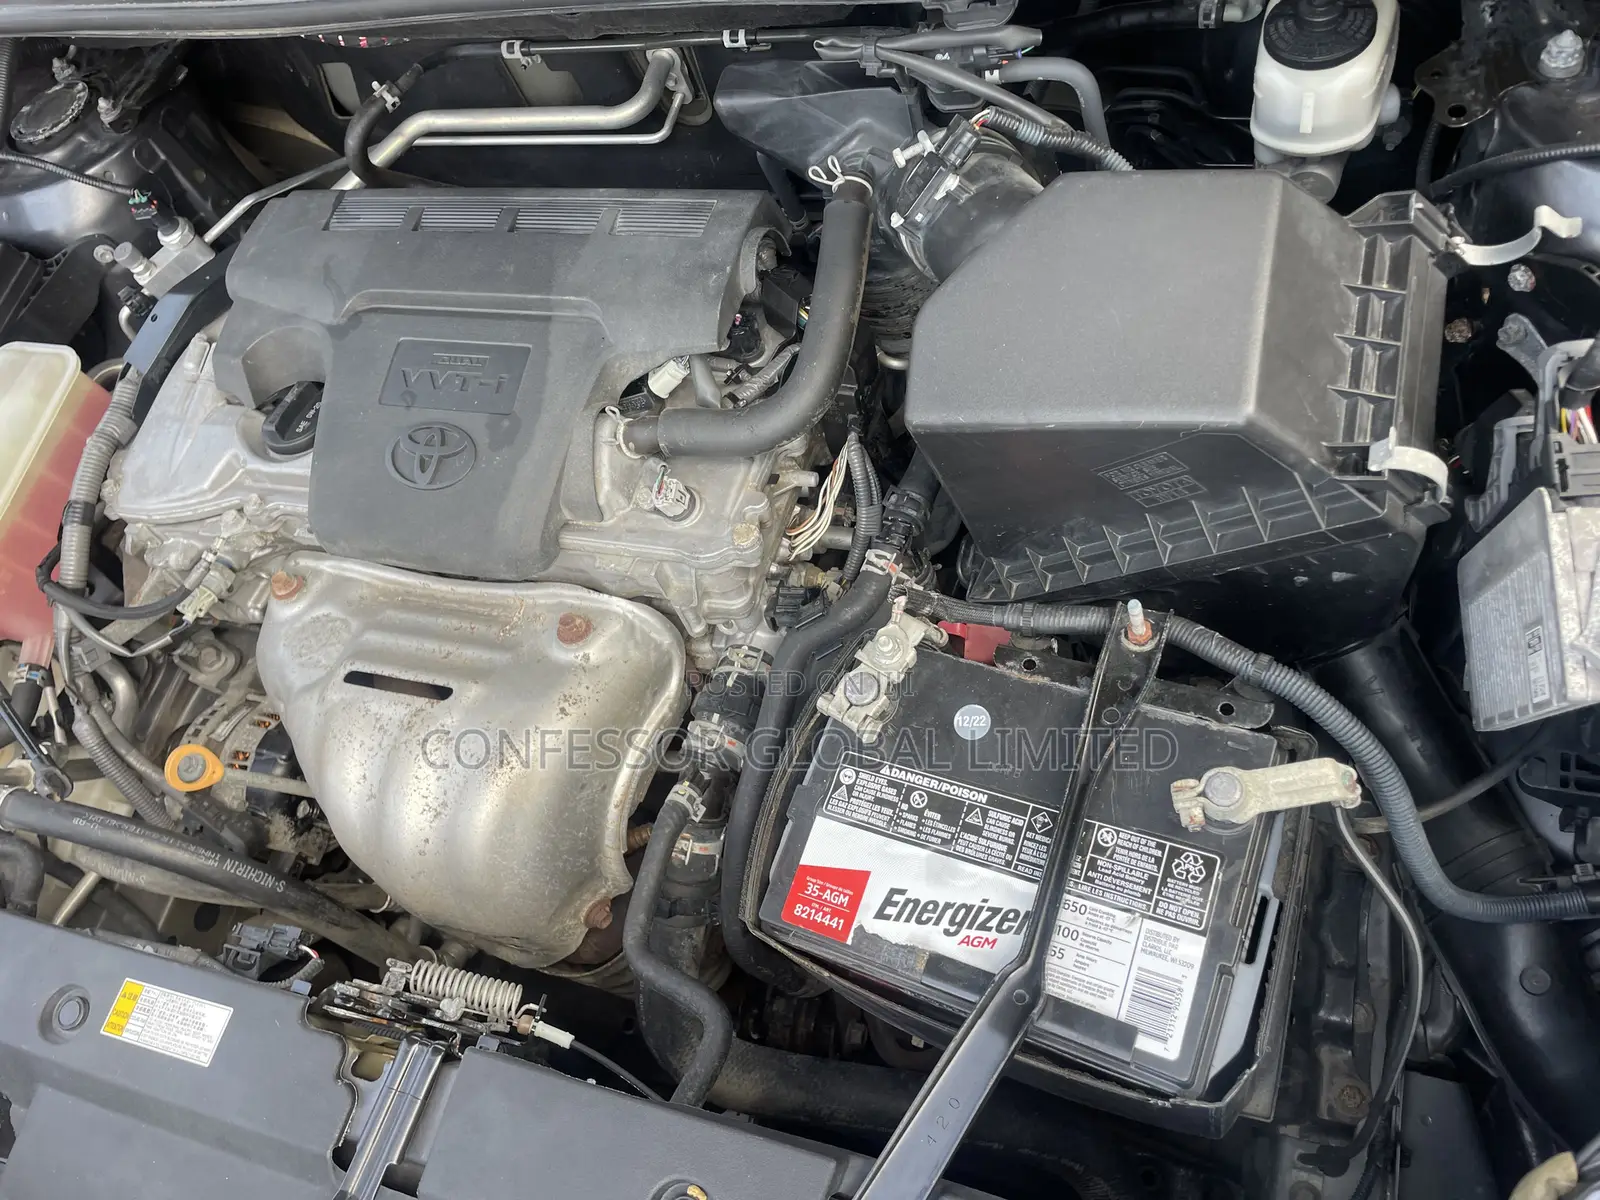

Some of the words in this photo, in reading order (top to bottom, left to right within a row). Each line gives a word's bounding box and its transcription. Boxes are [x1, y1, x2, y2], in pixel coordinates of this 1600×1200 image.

[400, 367, 509, 394] VVT-i
[958, 715, 987, 728] 12/22
[890, 768, 987, 804] DANGER/POISON
[1096, 859, 1149, 880] NON-SPILLABLE
[804, 882, 849, 907] 35-AGM
[1086, 870, 1103, 880] ANTI
[1102, 874, 1152, 895] DÉVERSEMENT
[1077, 883, 1091, 892] LIRE
[1091, 887, 1103, 896] LES
[1102, 891, 1149, 911] INSTRUCTIONS.
[792, 903, 844, 930] 8214441
[957, 935, 999, 950] AGM
[1055, 924, 1080, 941] 100
